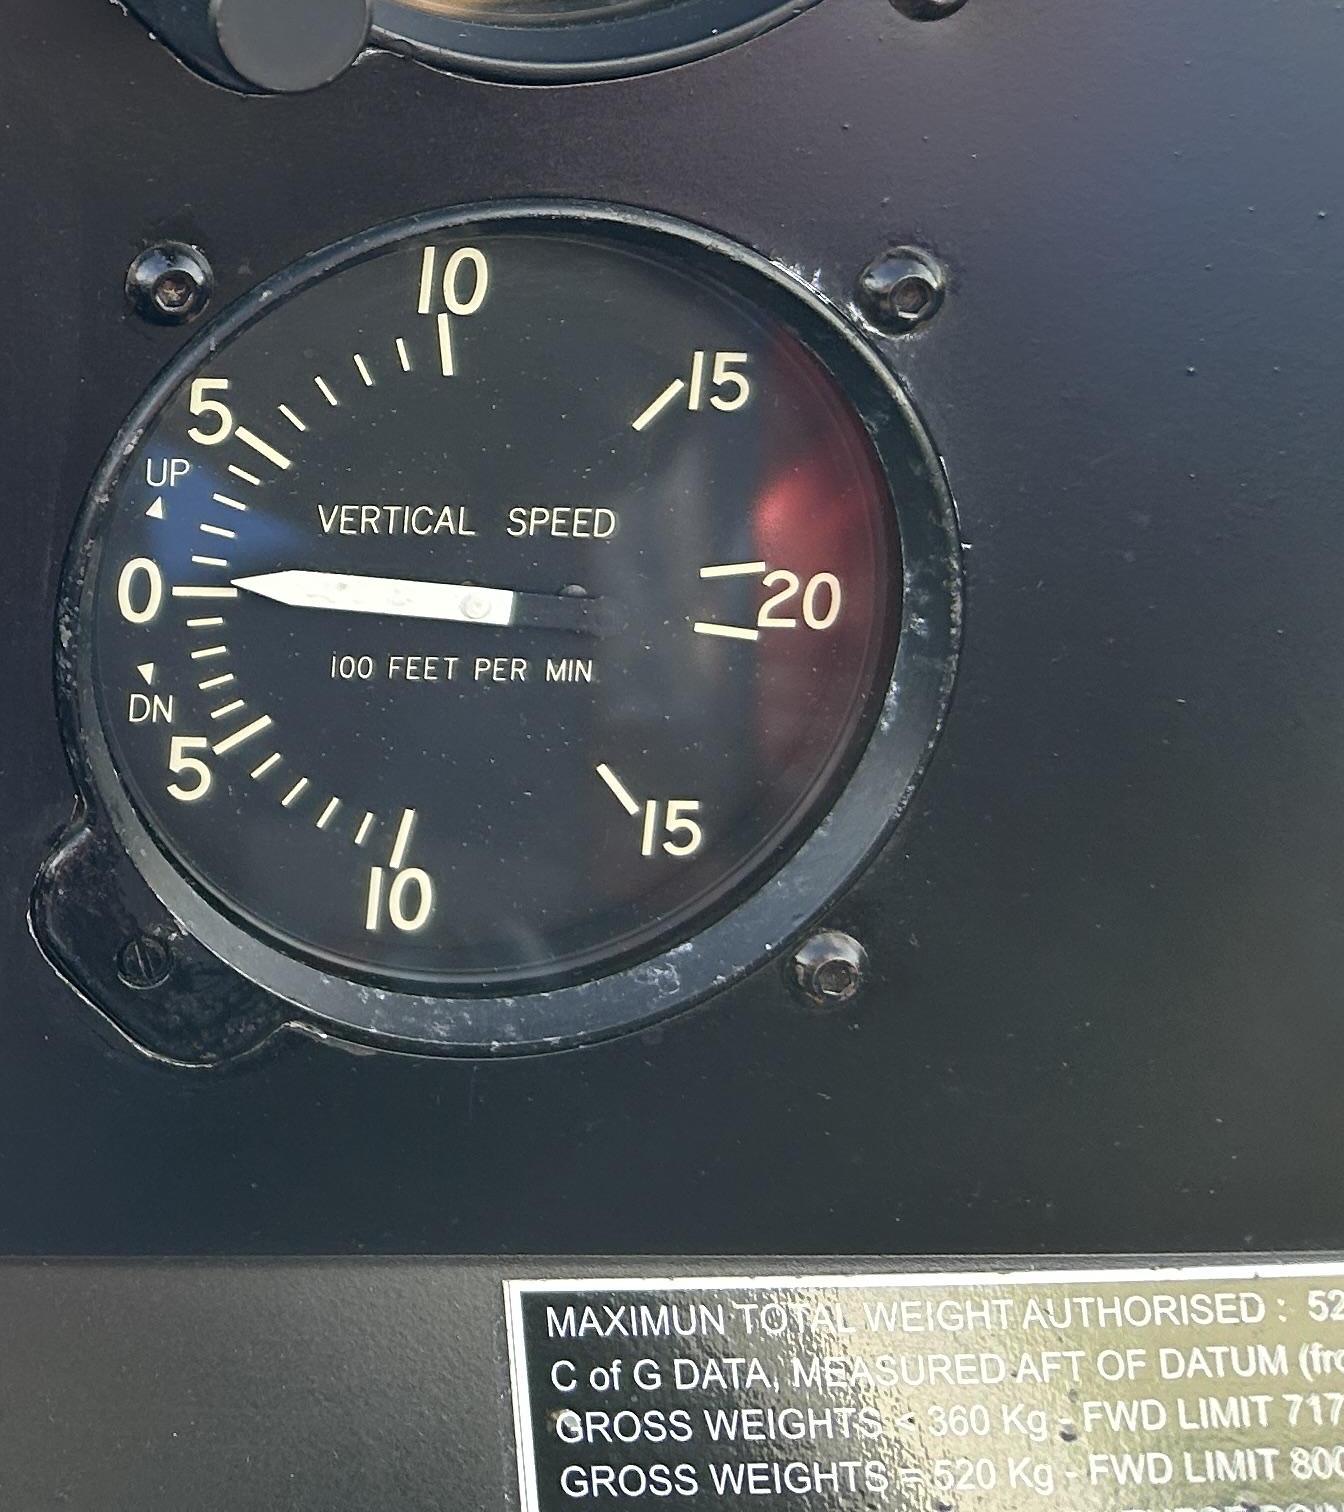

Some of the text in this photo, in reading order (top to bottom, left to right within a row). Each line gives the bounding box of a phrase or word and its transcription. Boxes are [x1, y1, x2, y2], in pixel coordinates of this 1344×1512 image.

[417, 245, 489, 316] 10
[687, 351, 749, 413] 15
[188, 378, 232, 445] 5
[145, 458, 190, 488] UP
[317, 505, 616, 538] VERTICAL SPEED
[117, 559, 162, 624] 0
[756, 571, 842, 629] 20
[330, 655, 593, 682] 100 FEET PER MIN
[128, 694, 174, 724] DN
[168, 737, 212, 801] 5
[641, 801, 702, 857] 15
[365, 868, 433, 931] 10
[547, 1303, 725, 1337] MAXIMUN
[735, 1301, 856, 1335] TOTAL
[863, 1299, 1012, 1332] WEIGHT
[1023, 1292, 1266, 1329] AUTHORISED
[551, 1360, 577, 1391] C
[589, 1359, 621, 1390] of
[634, 1359, 661, 1390] G
[674, 1357, 780, 1393] DATA,
[793, 1353, 1006, 1389] MEASURED
[1016, 1351, 1085, 1383] AFT
[1097, 1349, 1146, 1381] OF
[1160, 1344, 1289, 1379] DATUM
[555, 1409, 692, 1443] GROSS
[704, 1406, 883, 1440] WEIGHTS
[927, 1404, 991, 1437] 360
[1002, 1404, 1047, 1442] Kg
[1083, 1399, 1167, 1432] FWD
[1177, 1395, 1274, 1429] LIMIT
[1282, 1392, 1344, 1427] 717
[561, 1464, 698, 1498] GROSS
[709, 1460, 889, 1494] WEIGHTS
[932, 1458, 996, 1490] 520
[1007, 1456, 1053, 1496] Kg
[1088, 1452, 1173, 1485] FWD
[1184, 1448, 1279, 1482] LIMIT
